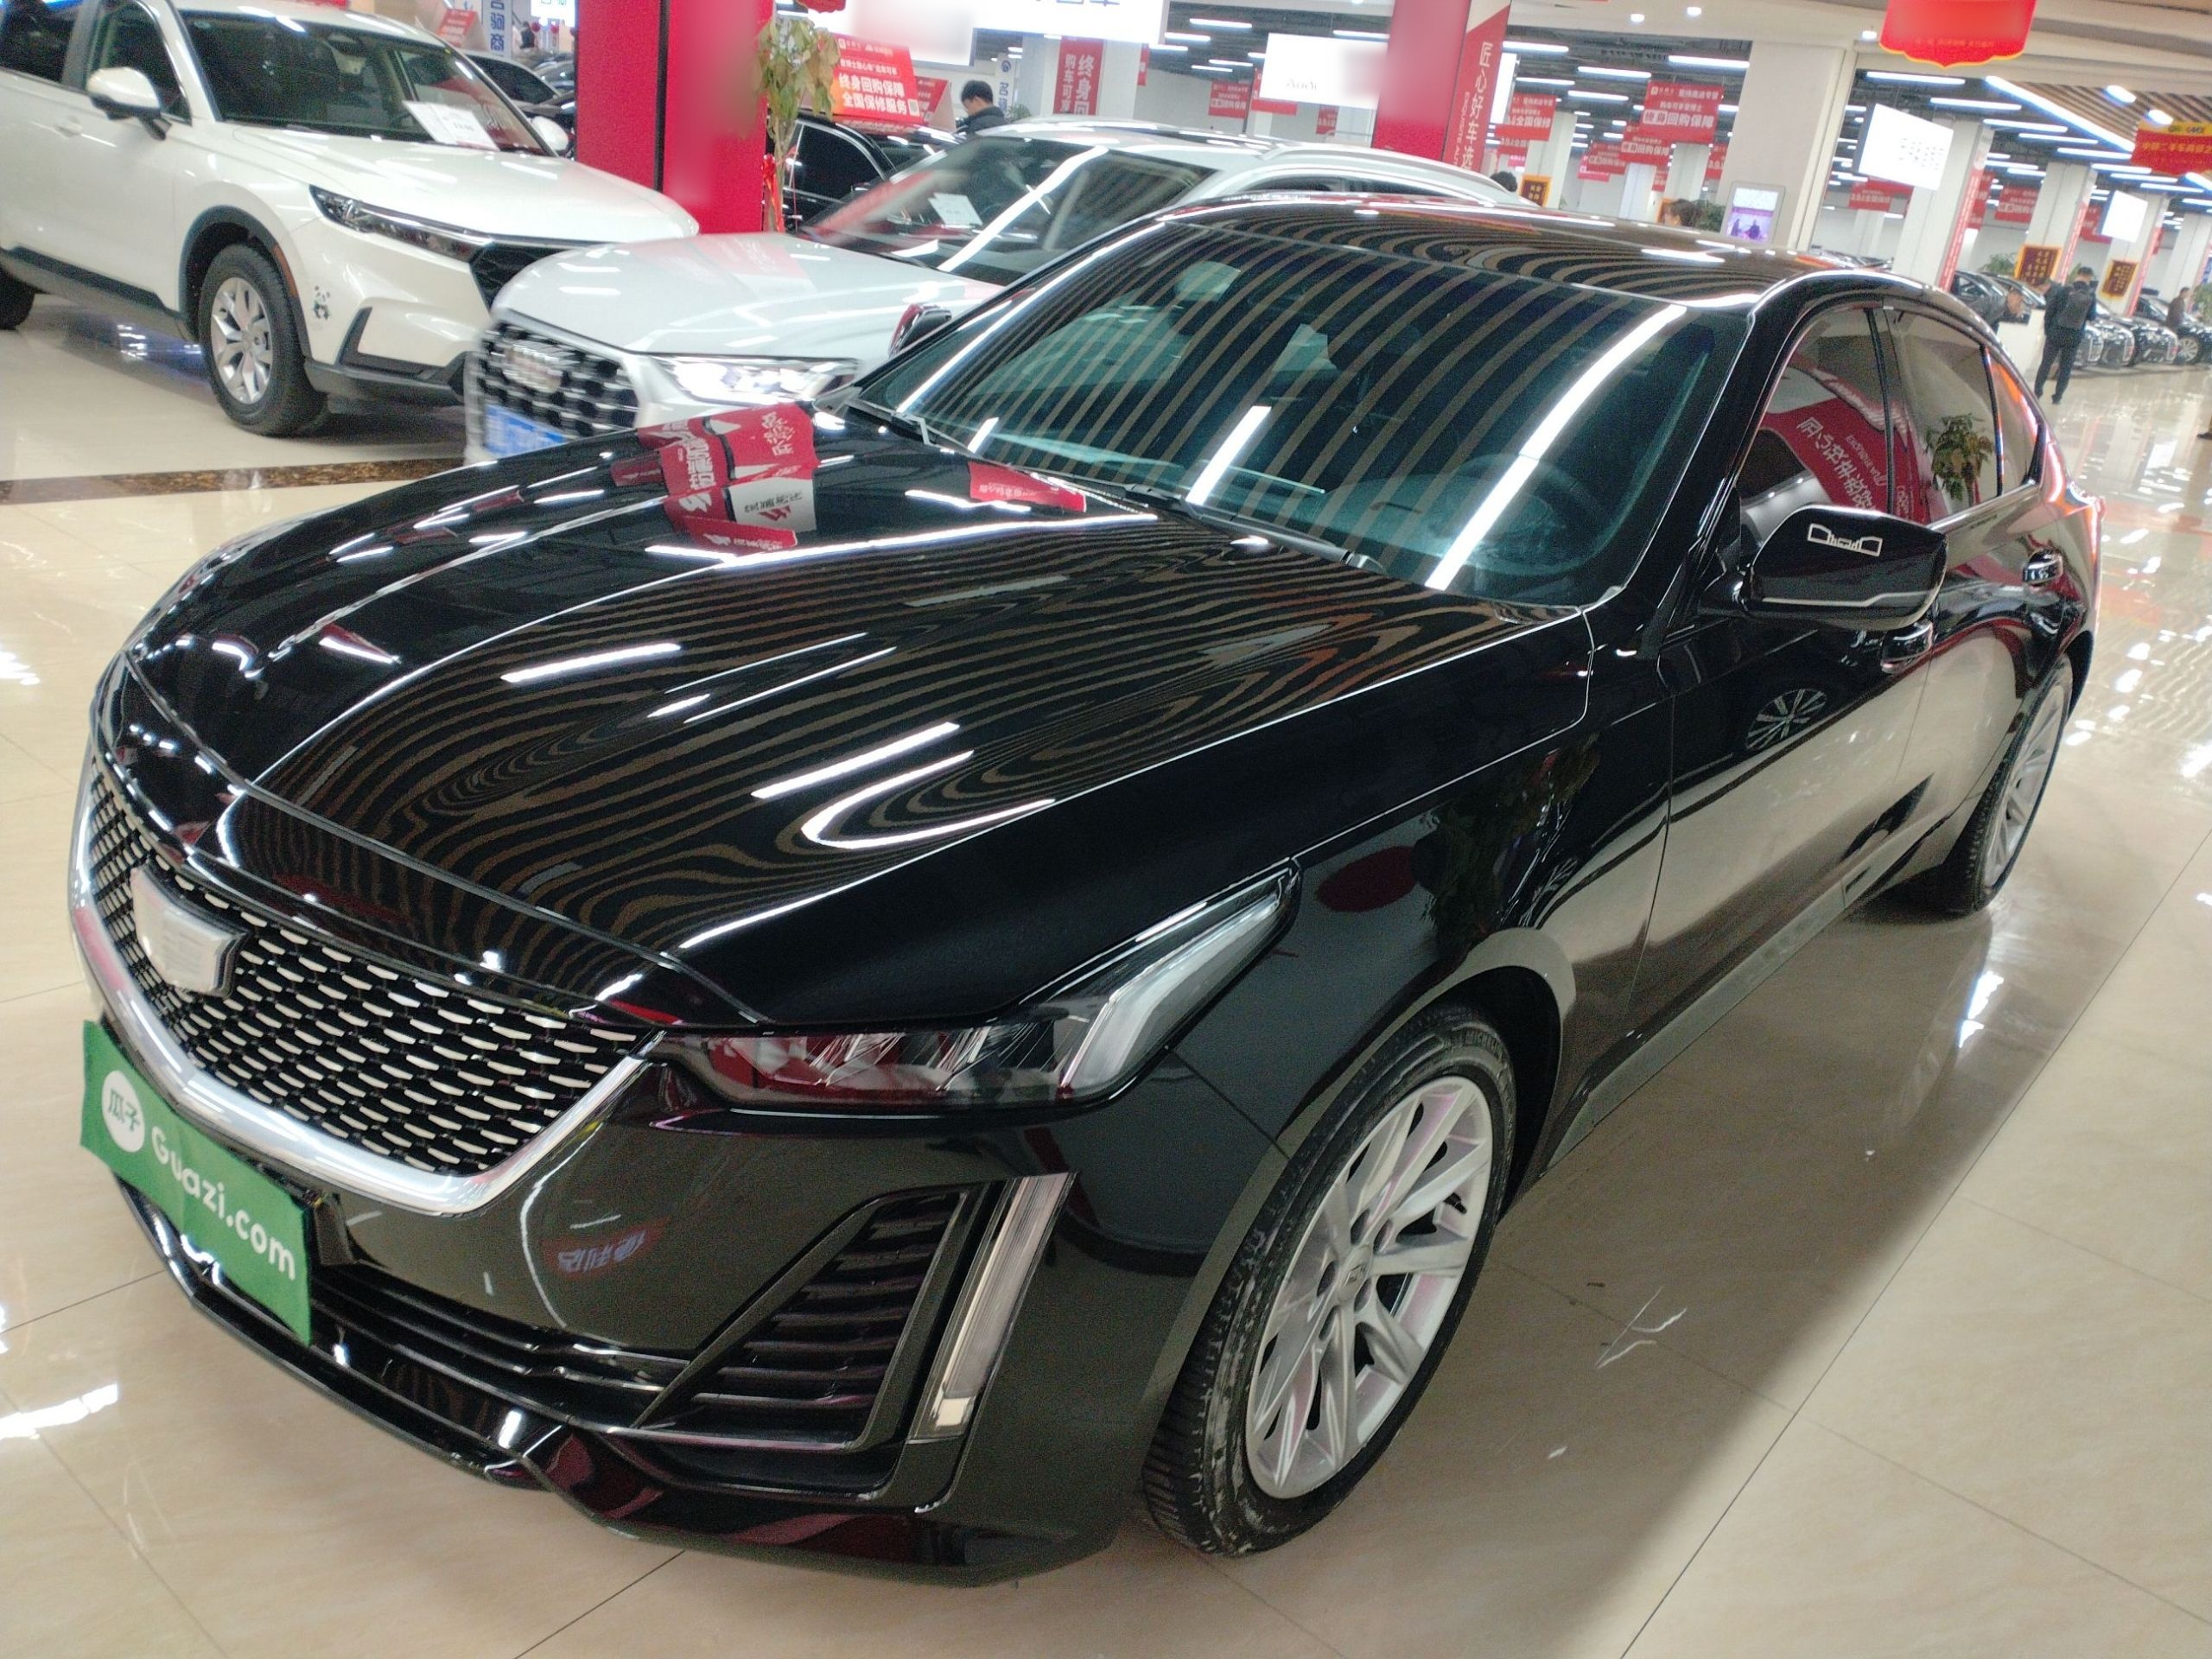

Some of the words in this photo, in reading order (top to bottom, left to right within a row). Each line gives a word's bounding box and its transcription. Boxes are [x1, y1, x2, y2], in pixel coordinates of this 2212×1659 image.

[838, 73, 905, 98] 终身回购保障
[842, 92, 907, 116] 全国保修服务
[107, 1089, 141, 1132] 瓜子
[151, 1126, 296, 1281] Guazi.com
